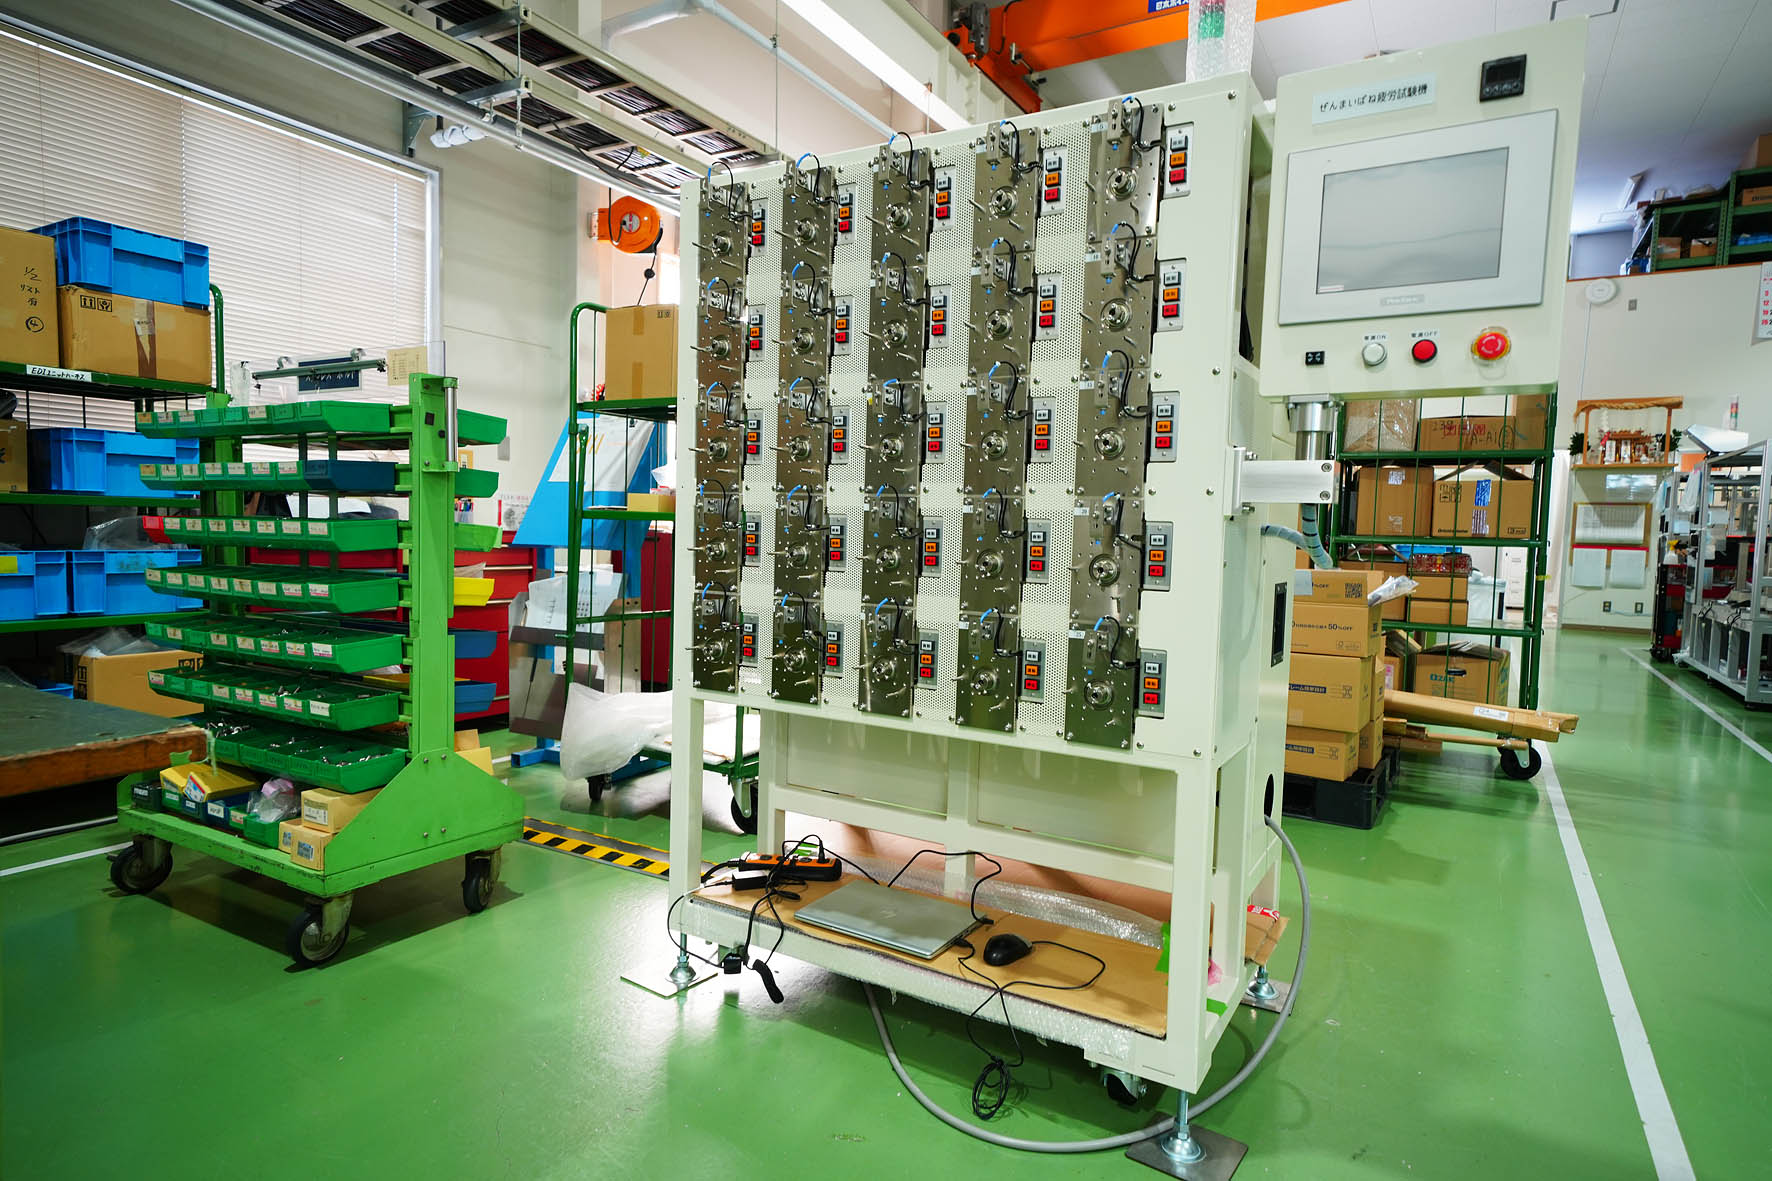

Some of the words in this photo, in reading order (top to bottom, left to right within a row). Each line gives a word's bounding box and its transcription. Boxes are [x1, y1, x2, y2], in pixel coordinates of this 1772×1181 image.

[1319, 83, 1428, 113] ぜんまいばね疲労試験機
